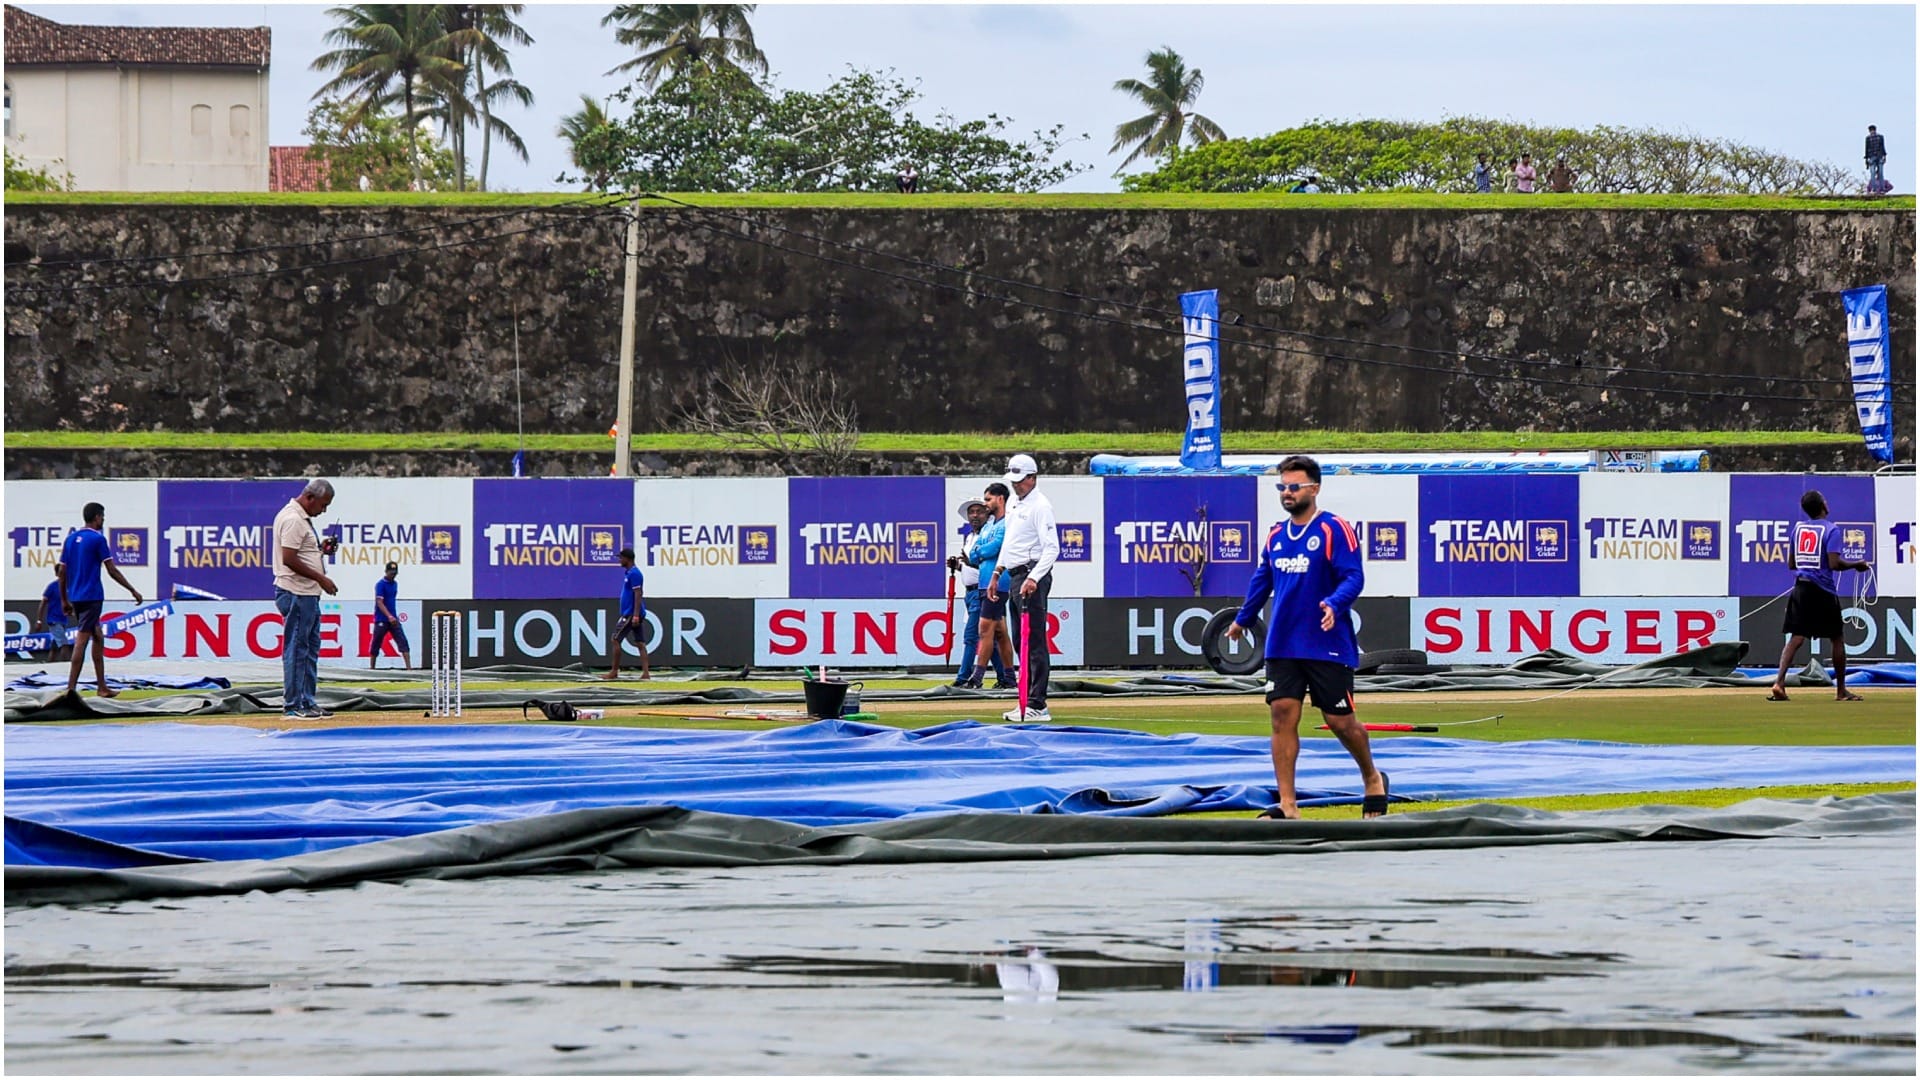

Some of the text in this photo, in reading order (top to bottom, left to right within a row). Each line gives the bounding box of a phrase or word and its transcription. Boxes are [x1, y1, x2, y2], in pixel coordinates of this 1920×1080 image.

[1183, 312, 1215, 432] RIDE
[1847, 309, 1886, 428] RIDE
[30, 527, 77, 546] TE
[186, 526, 261, 547] TEAM
[343, 524, 416, 544] TEAM
[505, 524, 579, 545] TEAM
[662, 525, 734, 545] TEAM
[821, 522, 894, 544] TEAM
[1135, 521, 1207, 543] TEAM
[1451, 520, 1524, 541] TEAM
[1605, 518, 1677, 539] TEAM
[184, 548, 260, 568] NATION
[342, 546, 416, 565] NATION
[503, 546, 579, 566] NATION
[660, 547, 734, 566] NATION
[819, 545, 894, 565] NATION
[1134, 543, 1207, 563] NATION
[1449, 542, 1524, 562] NATION
[1604, 540, 1677, 560] NATION
[1275, 553, 1310, 572] apollo
[116, 605, 169, 631] Kajaria
[468, 609, 708, 657] HONOR
[769, 609, 1063, 656] SING
[1425, 608, 1716, 655] SINGER
[4, 637, 46, 651] Kajar
